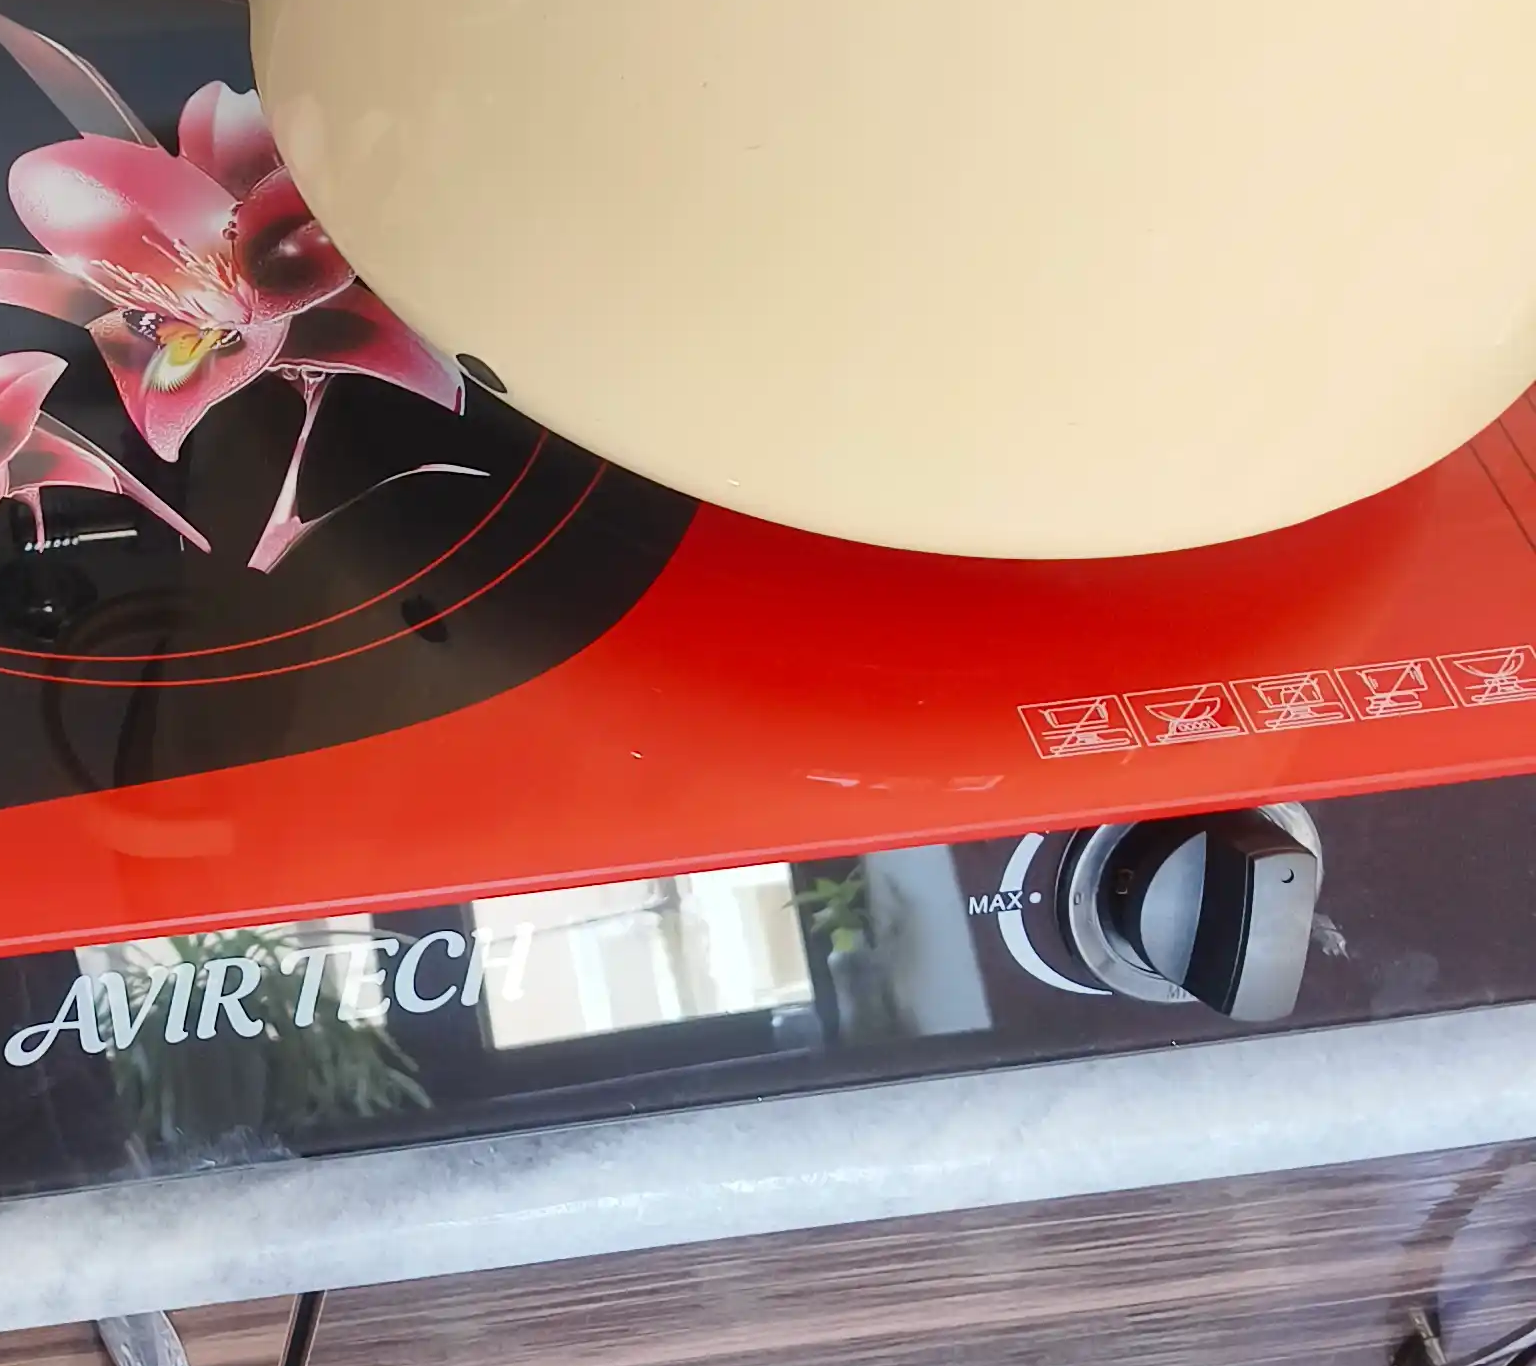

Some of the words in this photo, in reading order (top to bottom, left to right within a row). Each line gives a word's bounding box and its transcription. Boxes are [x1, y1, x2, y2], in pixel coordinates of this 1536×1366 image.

[969, 890, 1023, 916] MAX
[4, 957, 264, 1067] AVIR
[281, 922, 536, 1028] TECH
